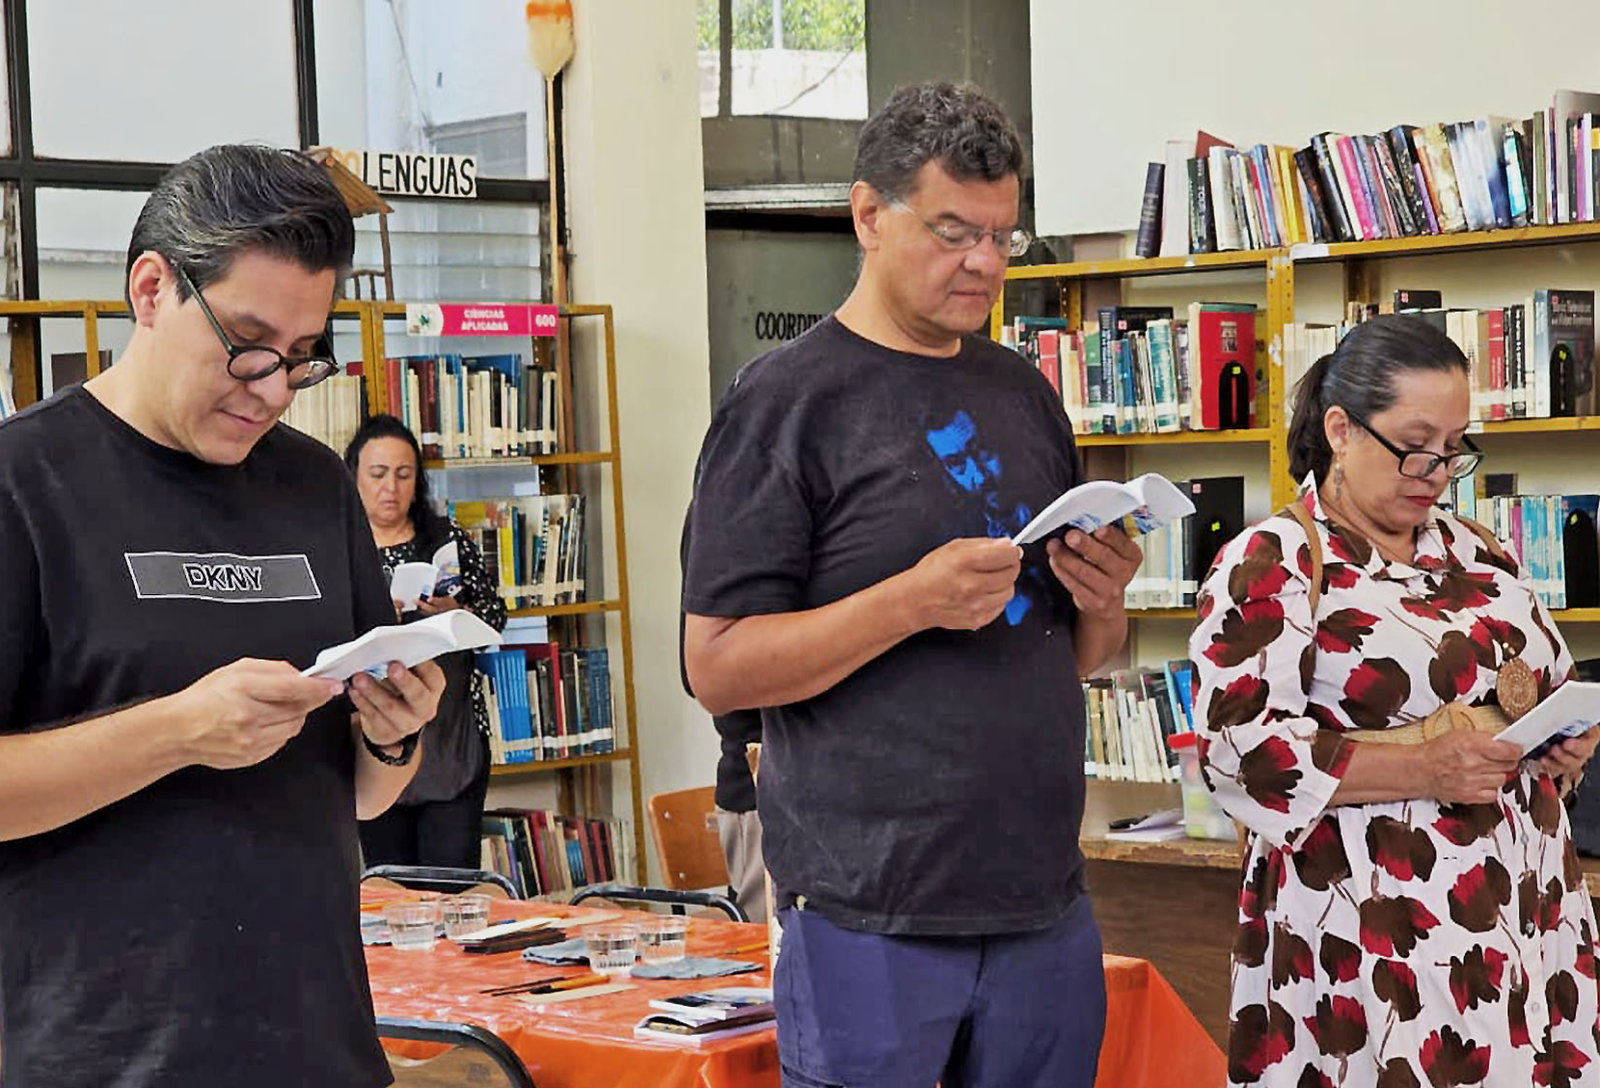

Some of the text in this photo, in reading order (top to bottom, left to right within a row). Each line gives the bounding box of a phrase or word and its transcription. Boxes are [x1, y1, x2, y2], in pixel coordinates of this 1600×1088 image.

[363, 152, 474, 196] LENGUAS
[535, 314, 556, 327] 600
[755, 311, 823, 340] COORDI
[183, 563, 262, 591] DKNY
